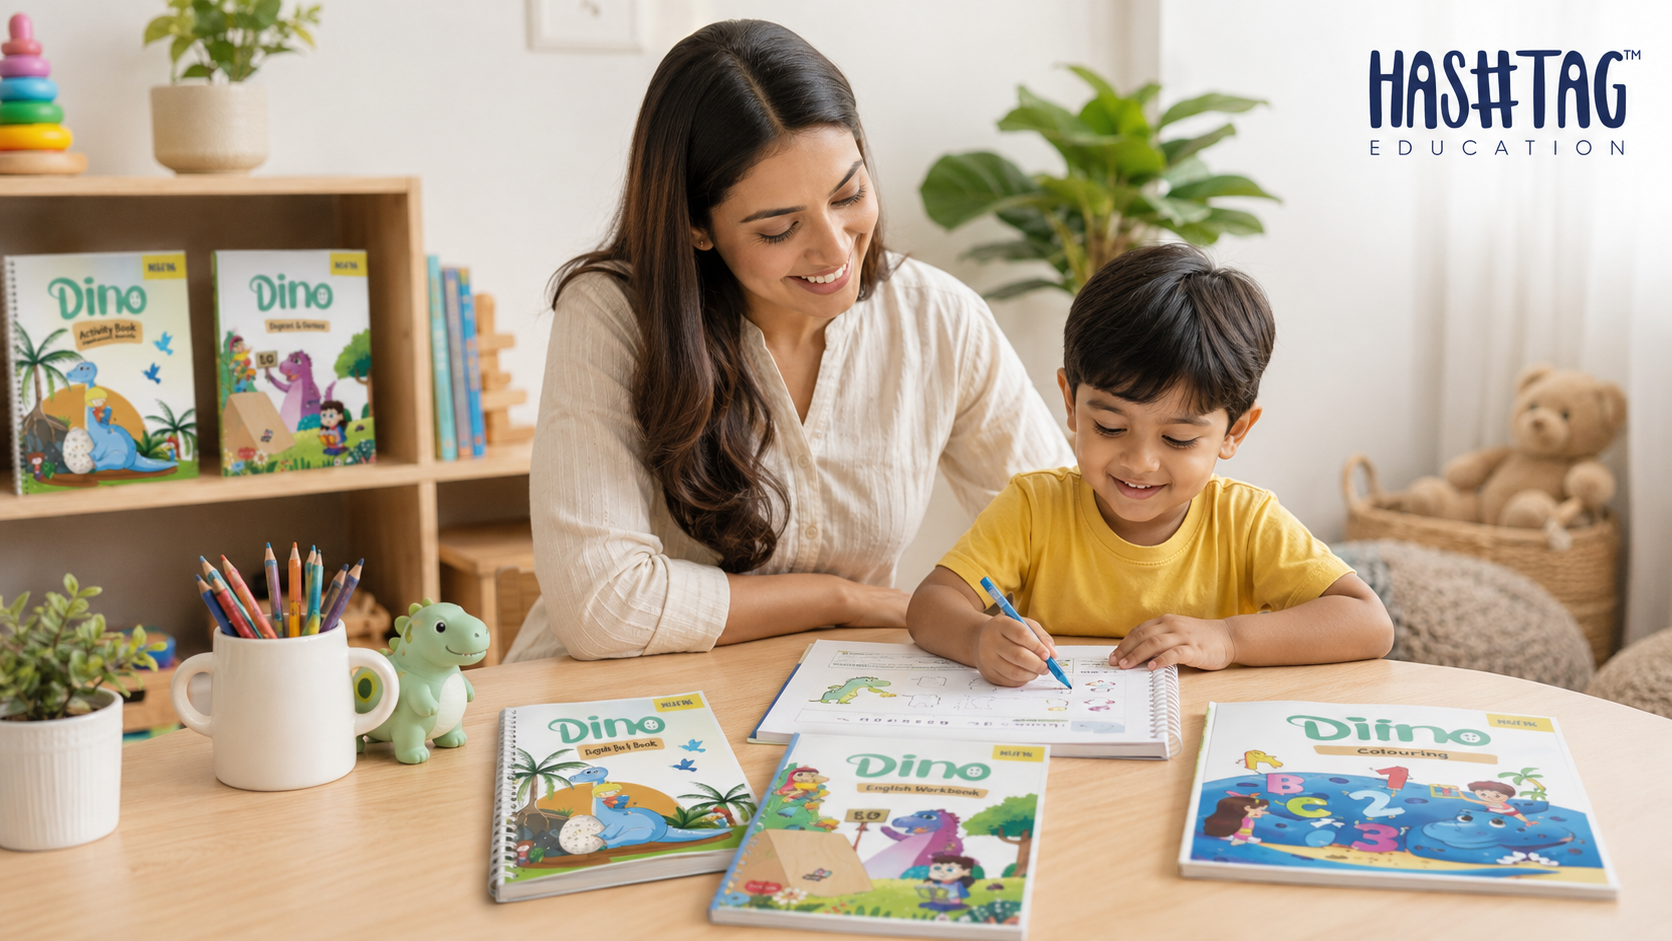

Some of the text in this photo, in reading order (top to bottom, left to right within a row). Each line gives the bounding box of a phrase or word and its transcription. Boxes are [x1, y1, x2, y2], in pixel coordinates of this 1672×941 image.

[48, 277, 147, 320] Dino
[248, 273, 334, 312] Dino
[79, 324, 113, 340] Activity
[114, 322, 137, 333] Book
[548, 715, 666, 744] Dino
[1357, 748, 1449, 759] Colouring
[846, 754, 991, 781] Dino
[866, 784, 980, 796] English Workbook
